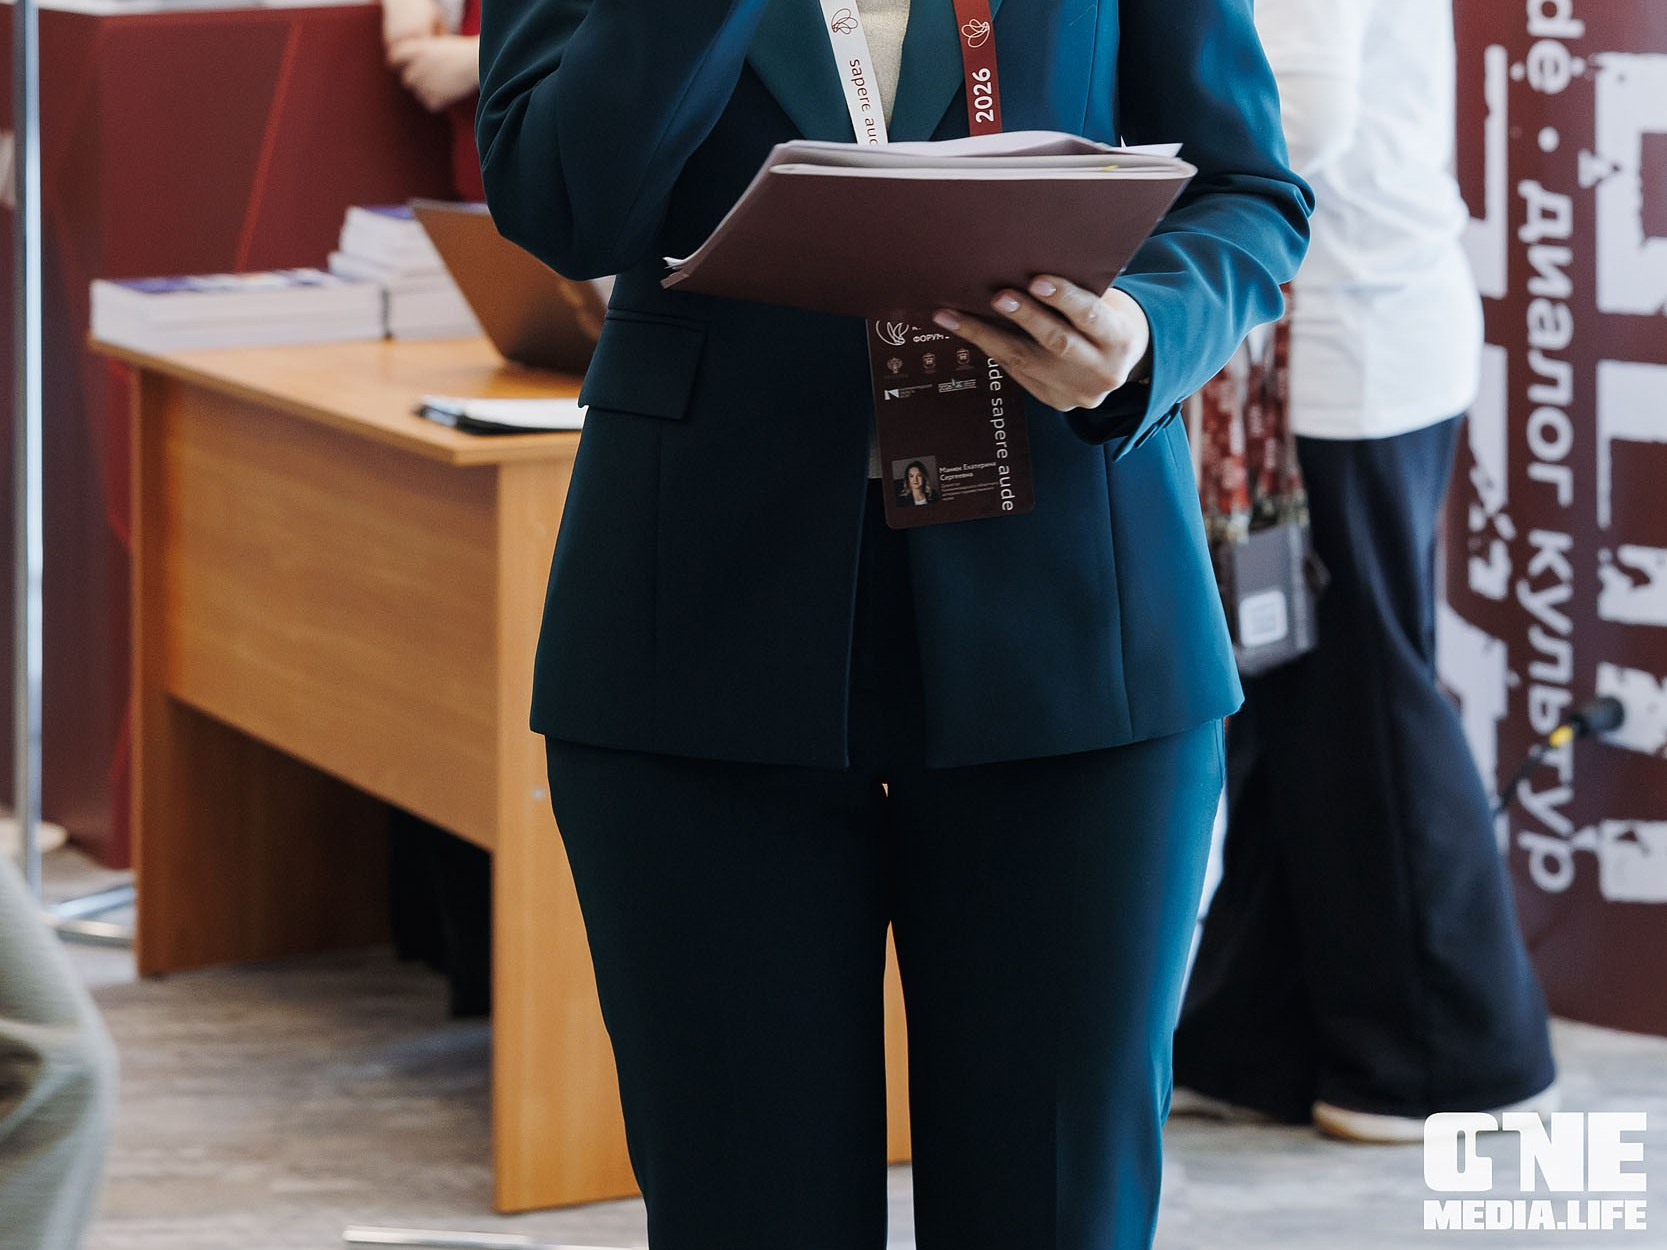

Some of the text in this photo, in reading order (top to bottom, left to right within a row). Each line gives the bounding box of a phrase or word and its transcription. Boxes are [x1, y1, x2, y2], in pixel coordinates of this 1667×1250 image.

[849, 58, 871, 112] sapere
[972, 67, 994, 123] 2026
[1518, 180, 1574, 506] диалог
[990, 397, 1008, 459] sapere
[998, 465, 1015, 511] aude
